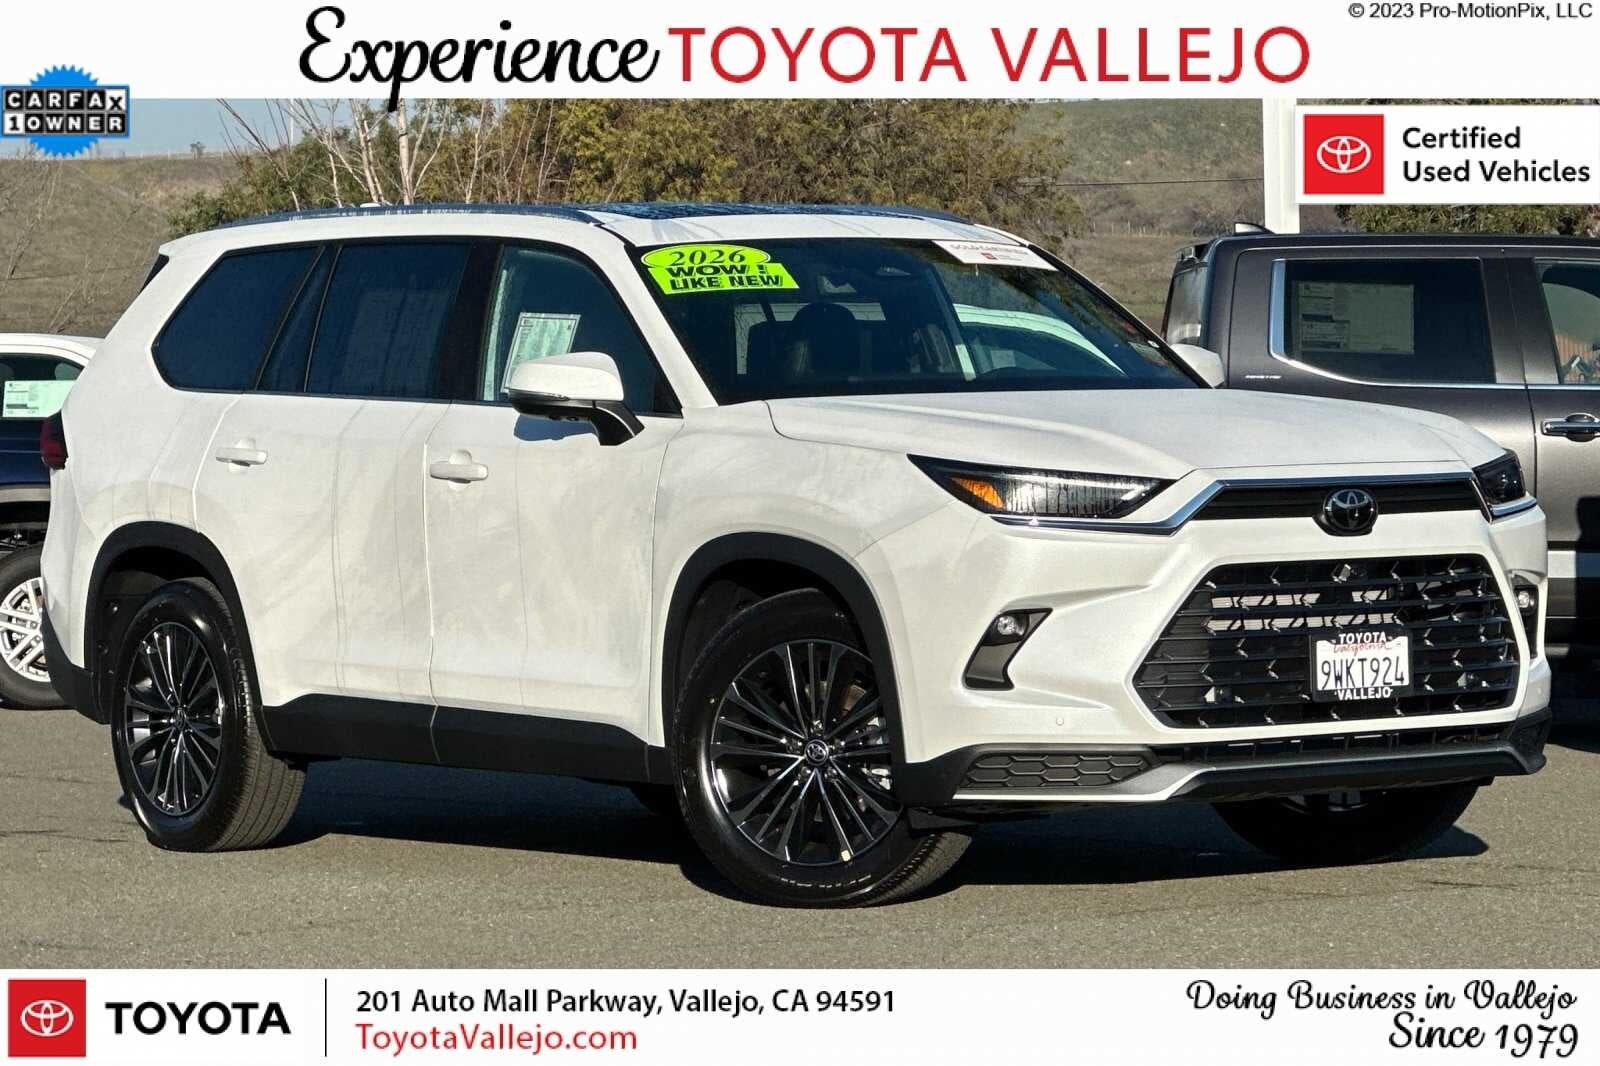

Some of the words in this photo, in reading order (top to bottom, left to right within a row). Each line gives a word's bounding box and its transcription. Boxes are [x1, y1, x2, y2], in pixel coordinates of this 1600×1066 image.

[668, 249, 746, 266] 2026
[669, 276, 721, 290] LIKE
[729, 275, 783, 287] NEW
[1338, 632, 1387, 645] TOYOTA
[1321, 656, 1404, 689] 9WKT924
[1337, 687, 1392, 700] VALLEJO
